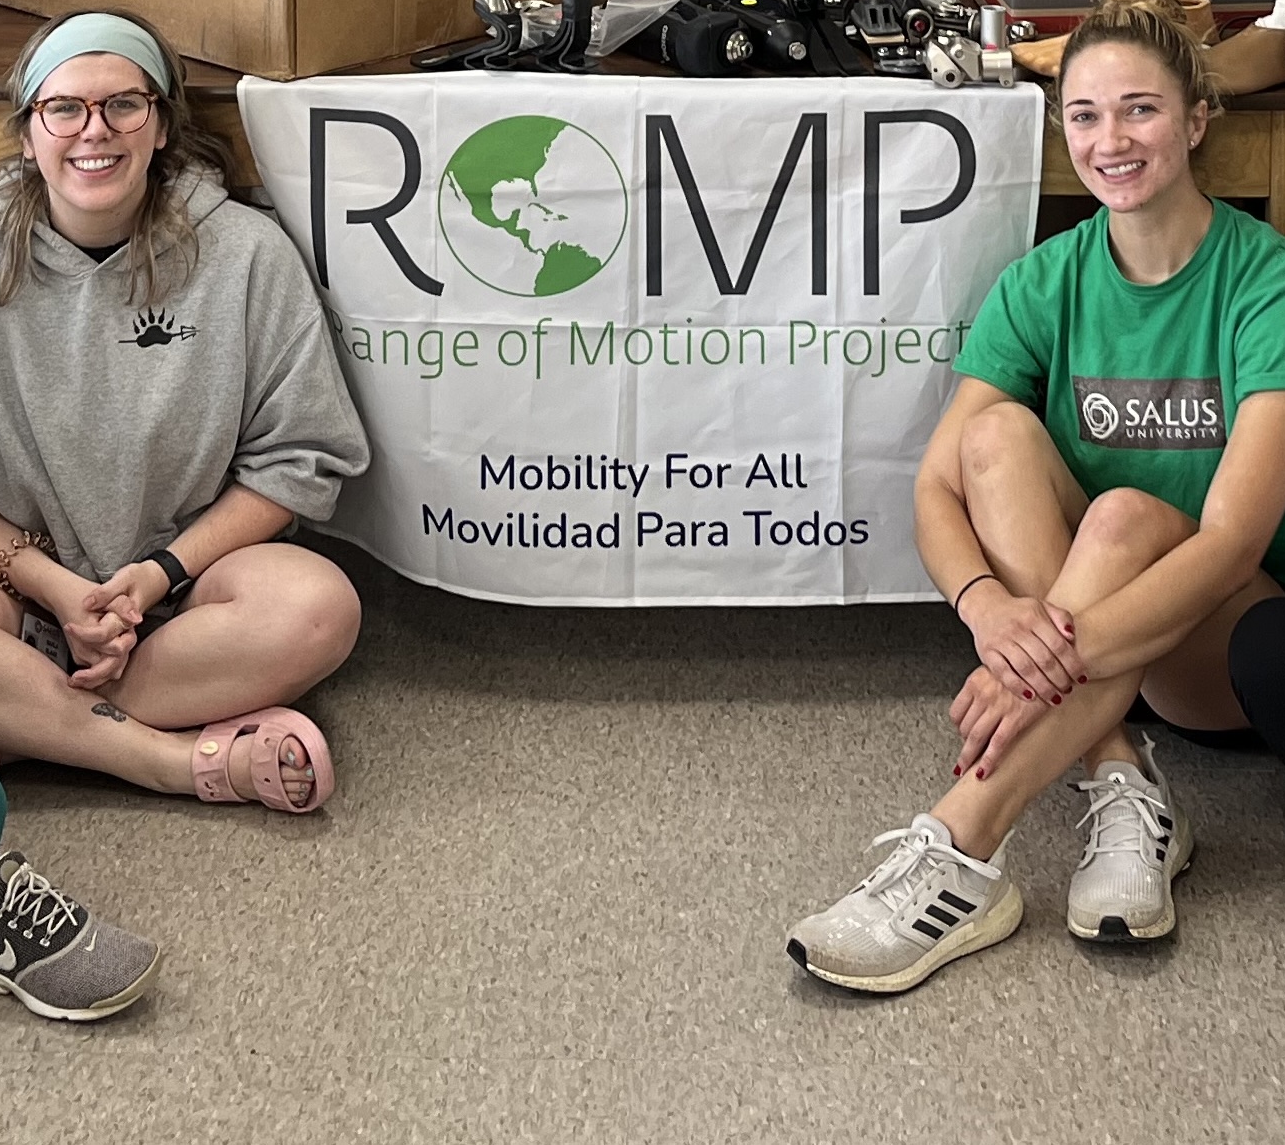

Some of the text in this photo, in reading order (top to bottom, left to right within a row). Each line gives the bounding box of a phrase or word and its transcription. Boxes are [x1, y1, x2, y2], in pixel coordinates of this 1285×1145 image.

[497, 317, 553, 380] of
[570, 317, 766, 366] Motion
[1126, 398, 1218, 427] SALUS
[1126, 427, 1218, 439] UNIVERSITY
[481, 453, 808, 498] Mobility For All
[422, 504, 869, 548] Movilidad Para Todos
